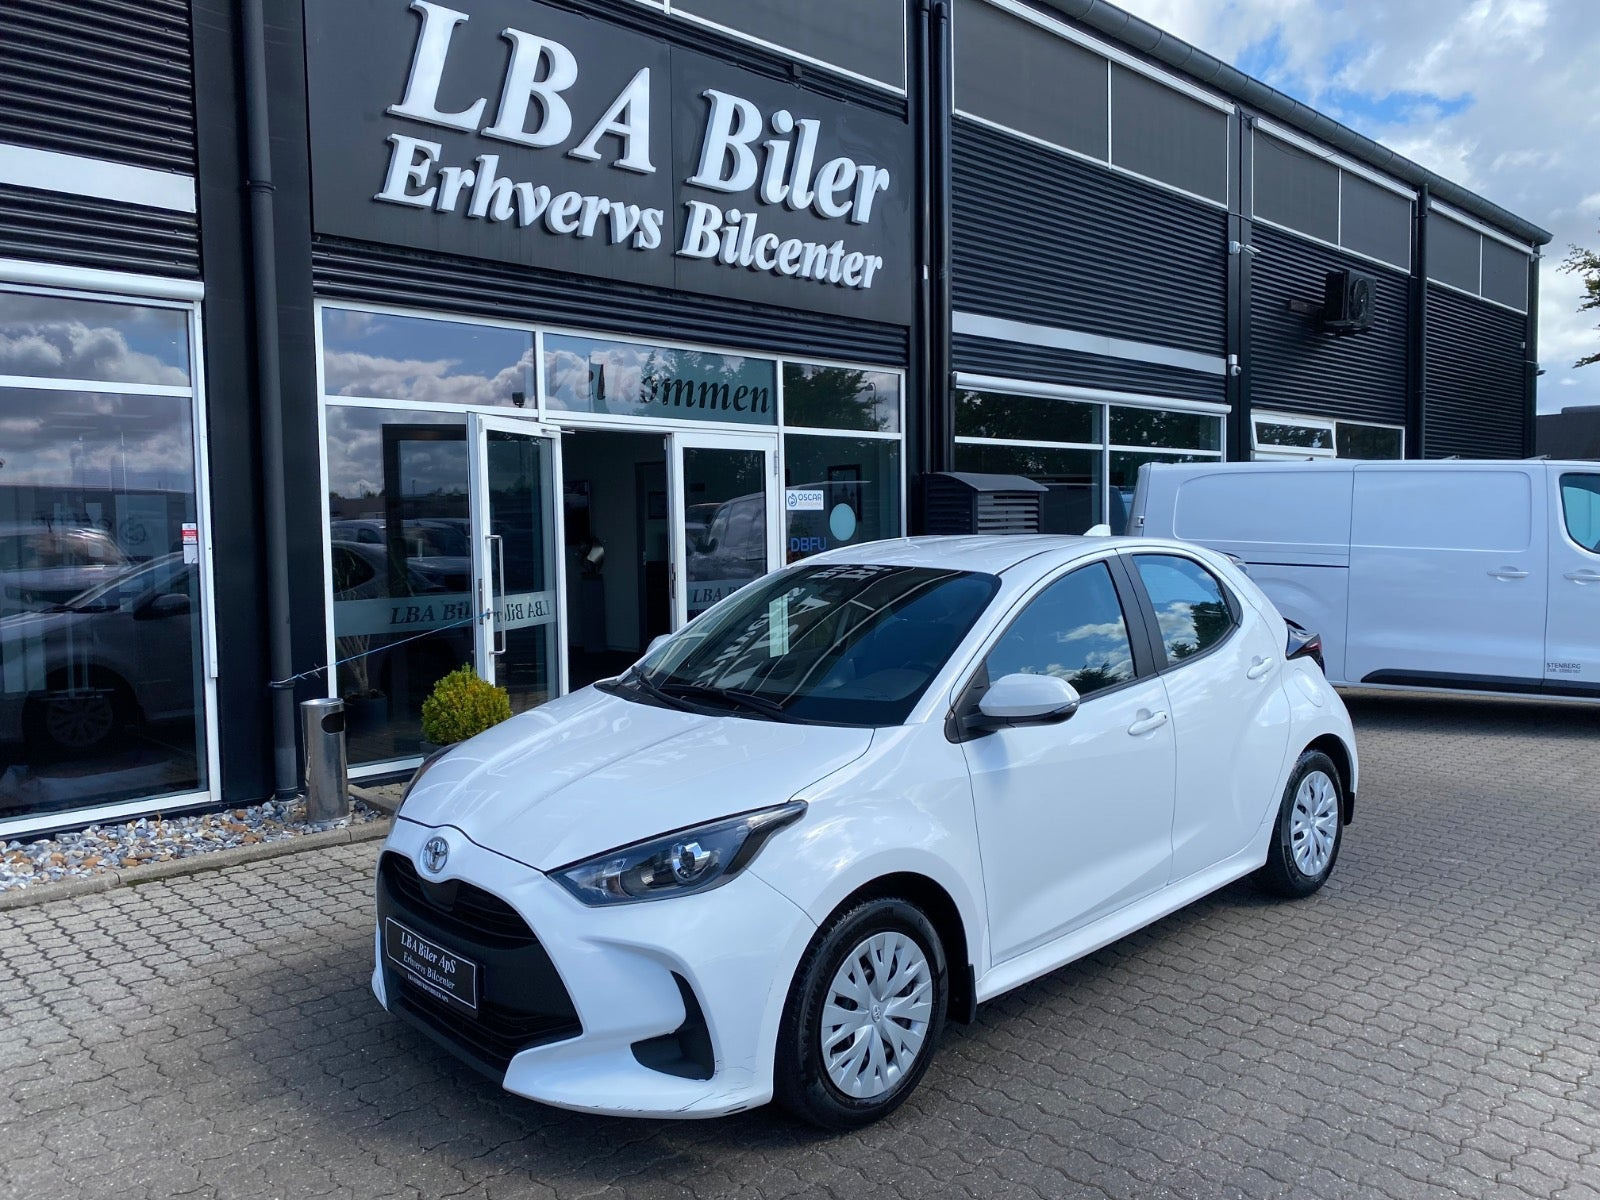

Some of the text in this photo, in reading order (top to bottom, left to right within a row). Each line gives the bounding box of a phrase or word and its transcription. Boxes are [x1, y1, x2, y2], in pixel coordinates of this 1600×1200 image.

[386, 0, 890, 225] LBA Biler
[374, 133, 883, 289] Erhvervs Bilcenter
[797, 493, 822, 502] OSCAR
[790, 536, 827, 552] DBFU
[389, 605, 436, 625] LBA
[401, 932, 457, 974] LBA Biler ApS
[403, 951, 427, 975] Erhvervs
[426, 966, 456, 990] Bilcenter
